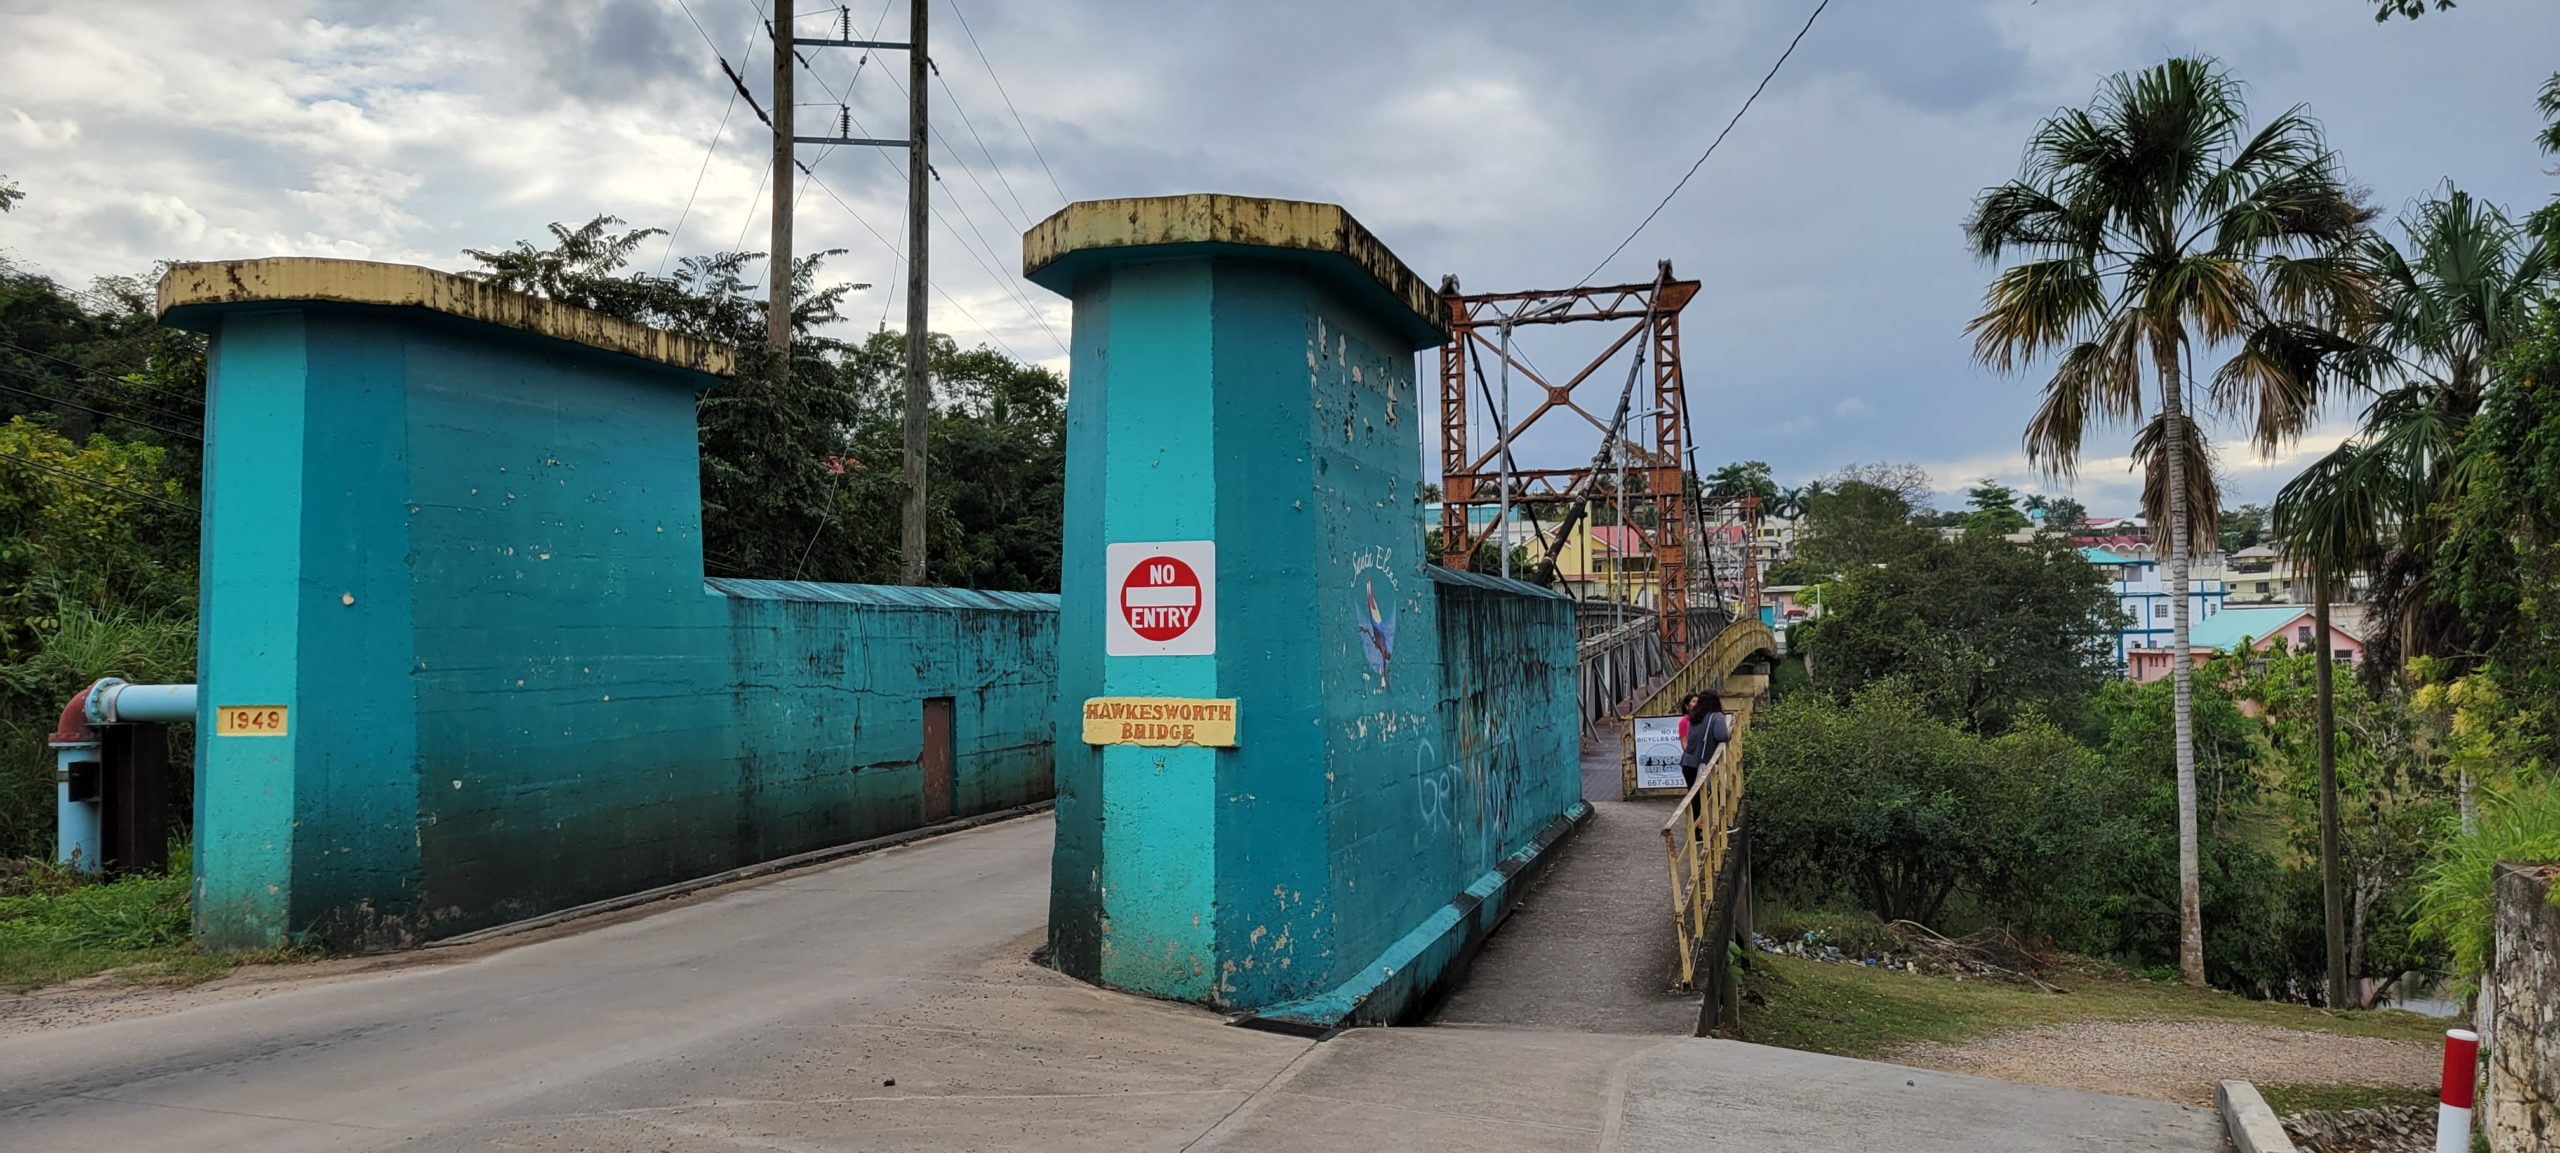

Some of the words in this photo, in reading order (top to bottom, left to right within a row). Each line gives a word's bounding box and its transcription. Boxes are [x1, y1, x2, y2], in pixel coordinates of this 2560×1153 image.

[1150, 564, 1175, 585] NO
[1350, 547, 1374, 588] Santa
[1376, 544, 1400, 592] Elena
[1131, 607, 1193, 629] ENTRY
[230, 711, 280, 730] 1949
[1086, 702, 1232, 721] HAWKESWORTH
[1121, 722, 1195, 740] BRIDGE
